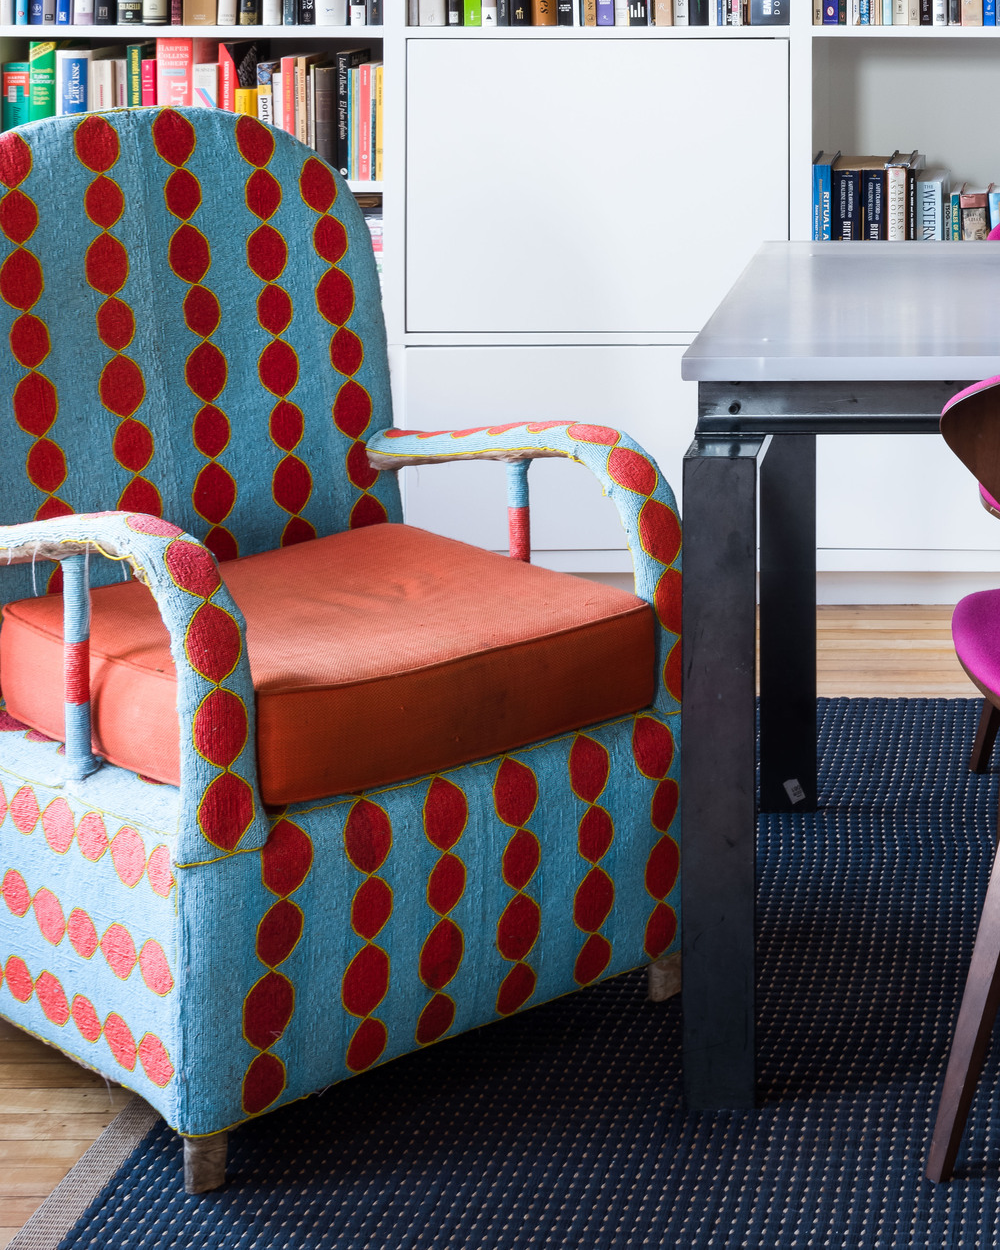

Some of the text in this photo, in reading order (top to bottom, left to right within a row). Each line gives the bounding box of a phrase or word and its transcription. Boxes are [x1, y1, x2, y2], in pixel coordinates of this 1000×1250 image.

[70, 63, 81, 104] Larousse
[131, 49, 140, 104] PORTUGUÊS BÁSICO PARA
[338, 57, 347, 96] Isabel Allende
[923, 189, 936, 240] WESTERN
